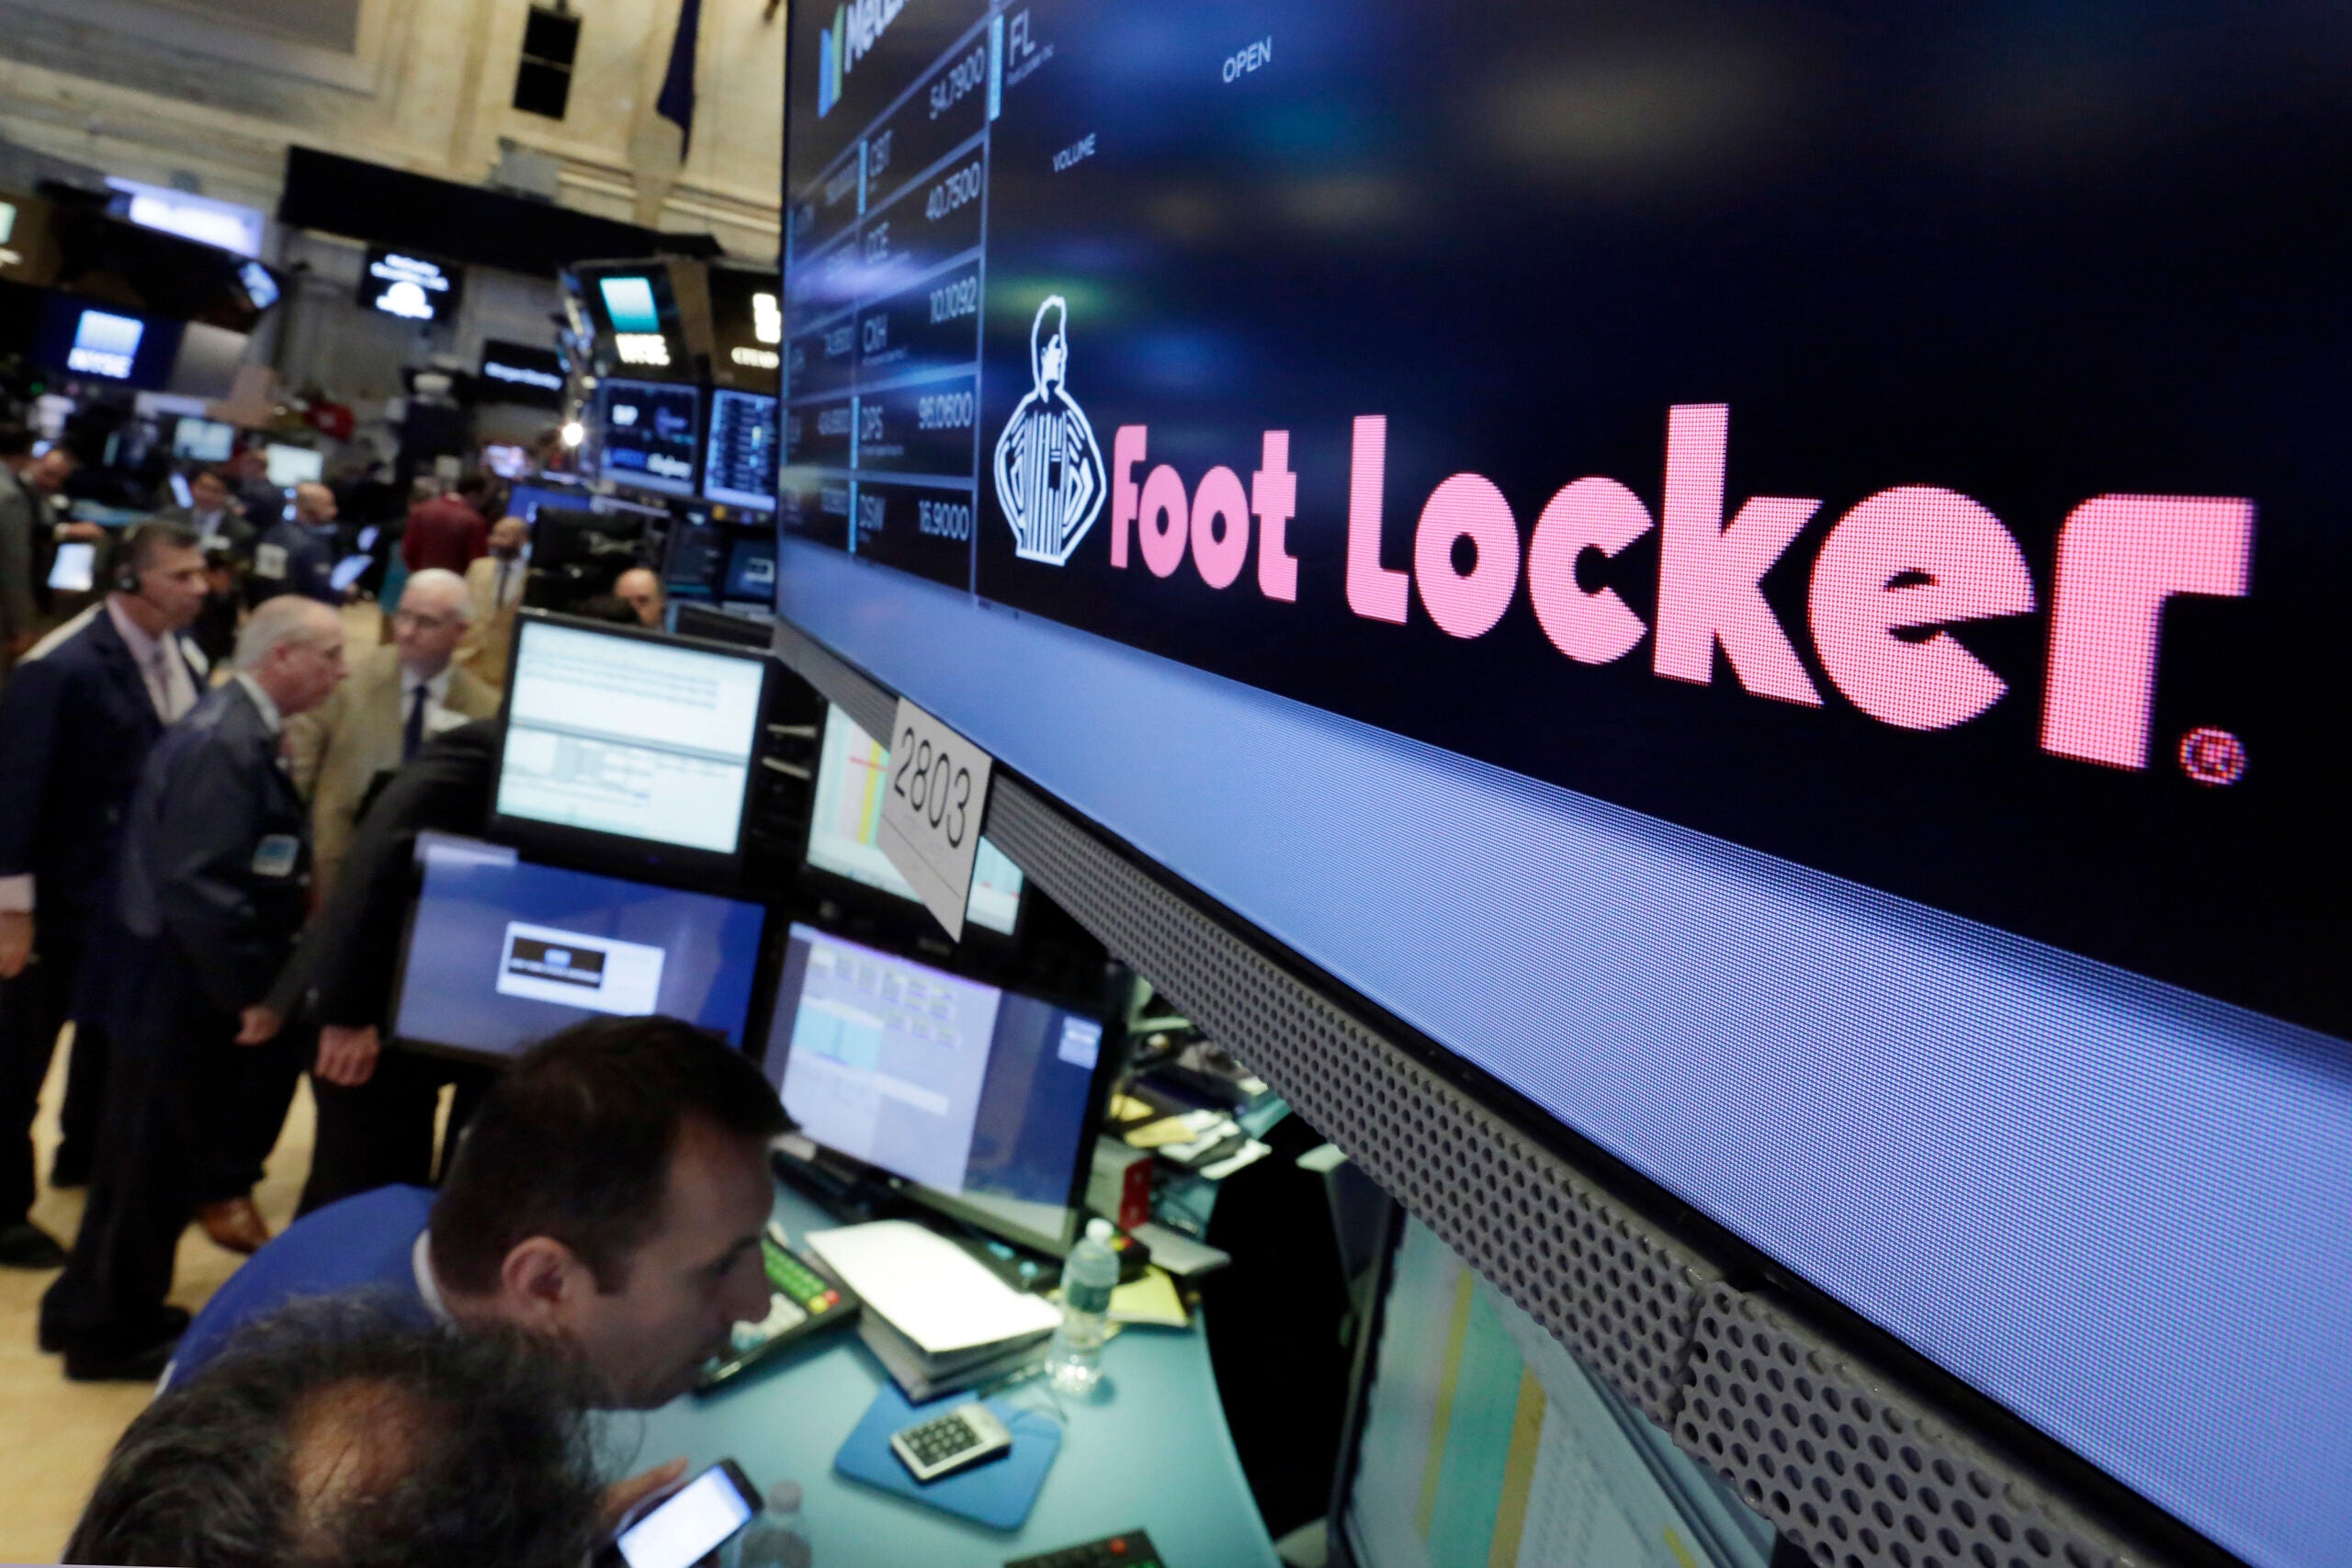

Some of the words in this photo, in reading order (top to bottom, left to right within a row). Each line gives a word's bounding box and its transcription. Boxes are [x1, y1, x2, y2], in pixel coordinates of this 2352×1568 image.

[1010, 8, 1035, 67] FL
[1222, 35, 1272, 84] OPEN
[1053, 132, 1096, 173] VOLUME
[1112, 425, 1297, 601] Foot
[1347, 404, 2252, 767] Locker
[894, 727, 971, 850] 2803
